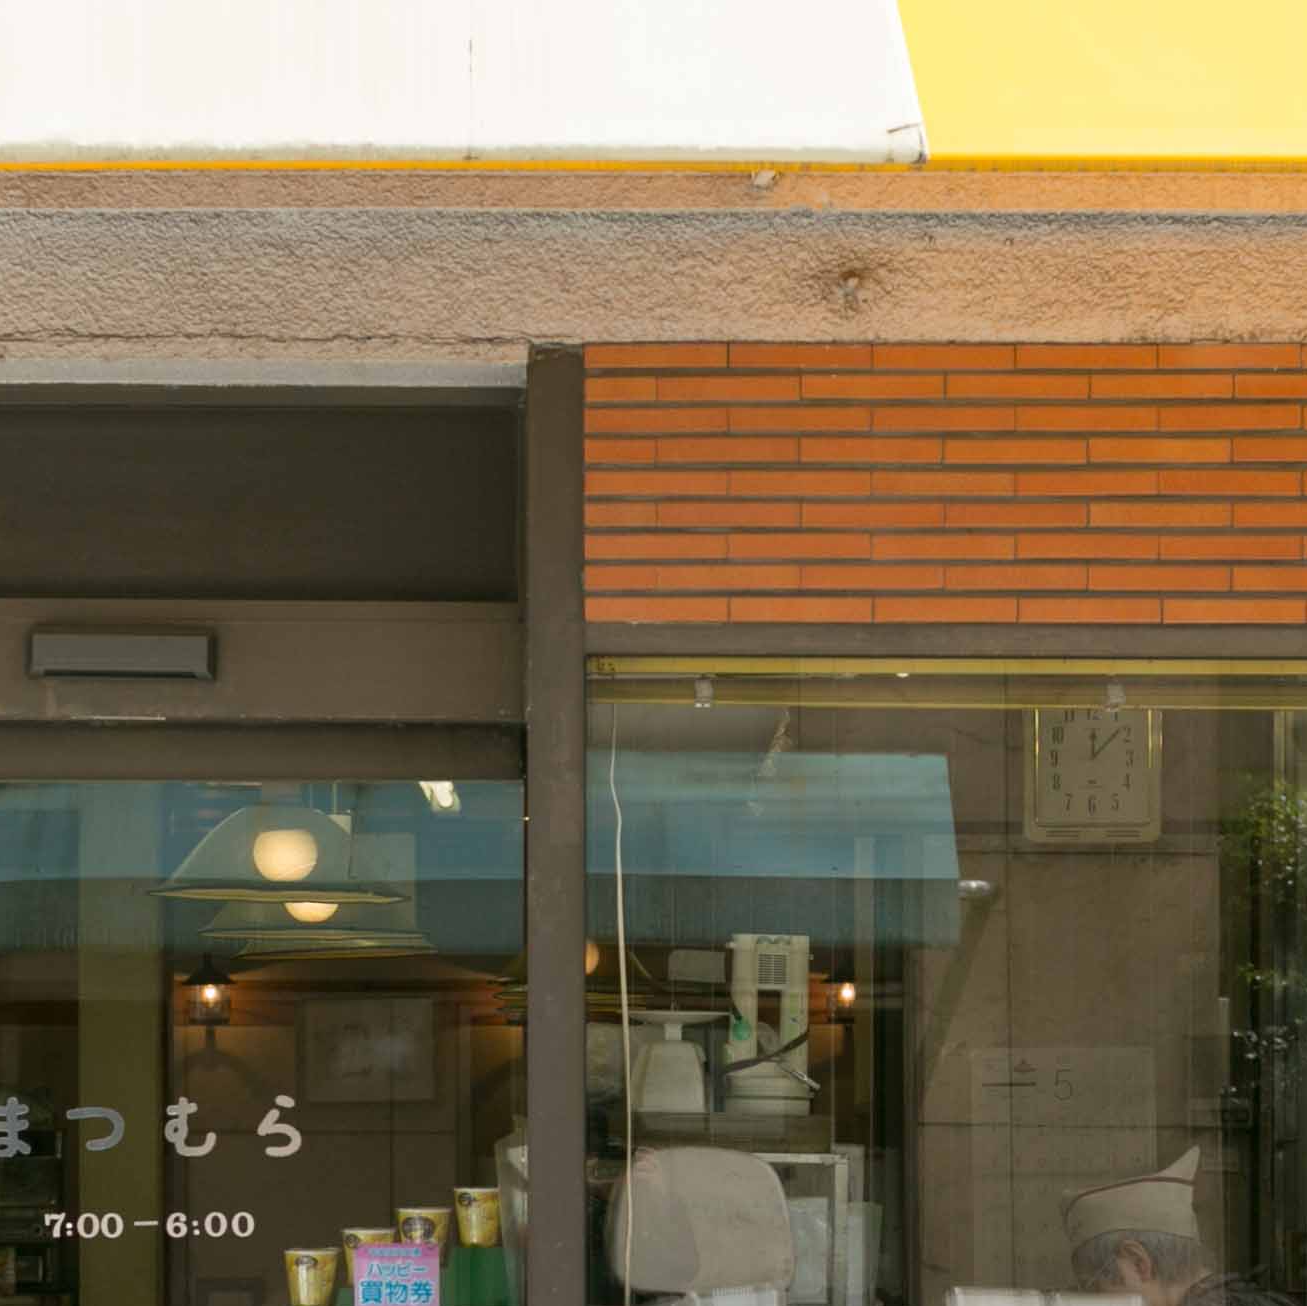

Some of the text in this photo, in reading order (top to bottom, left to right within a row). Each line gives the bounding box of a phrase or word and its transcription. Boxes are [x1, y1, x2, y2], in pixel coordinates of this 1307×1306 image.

[365, 1260, 428, 1278] ハッピー
[358, 1280, 434, 1305] 買物券
